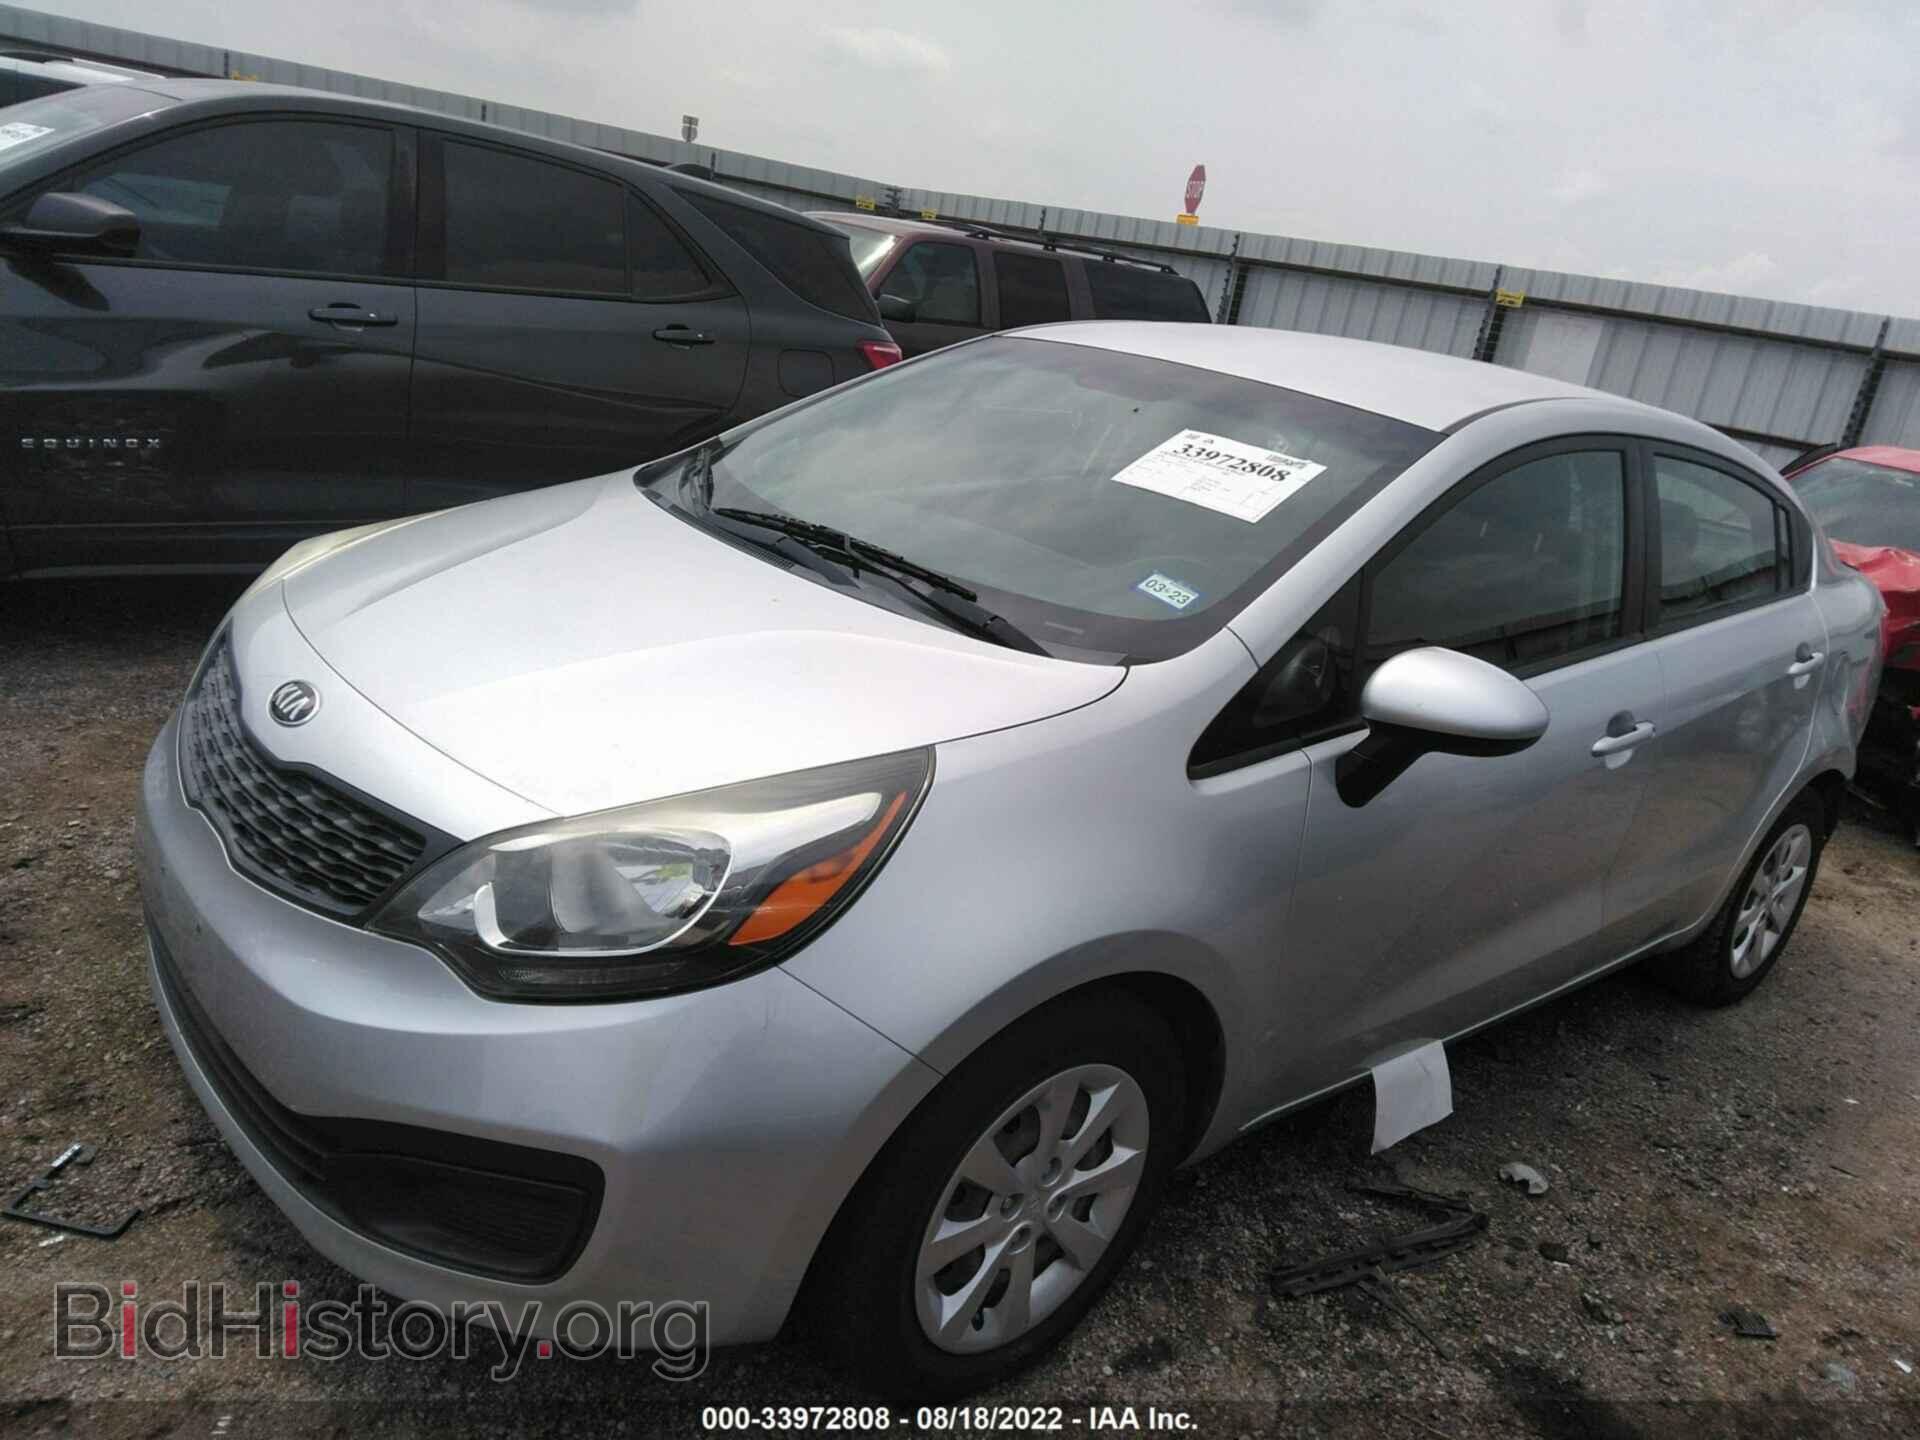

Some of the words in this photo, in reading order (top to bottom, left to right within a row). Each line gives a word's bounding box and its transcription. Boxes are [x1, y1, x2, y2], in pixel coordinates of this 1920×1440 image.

[1186, 181, 1205, 199] STOP
[21, 438, 160, 449] EQUINOX
[1174, 443, 1291, 482] 33972808
